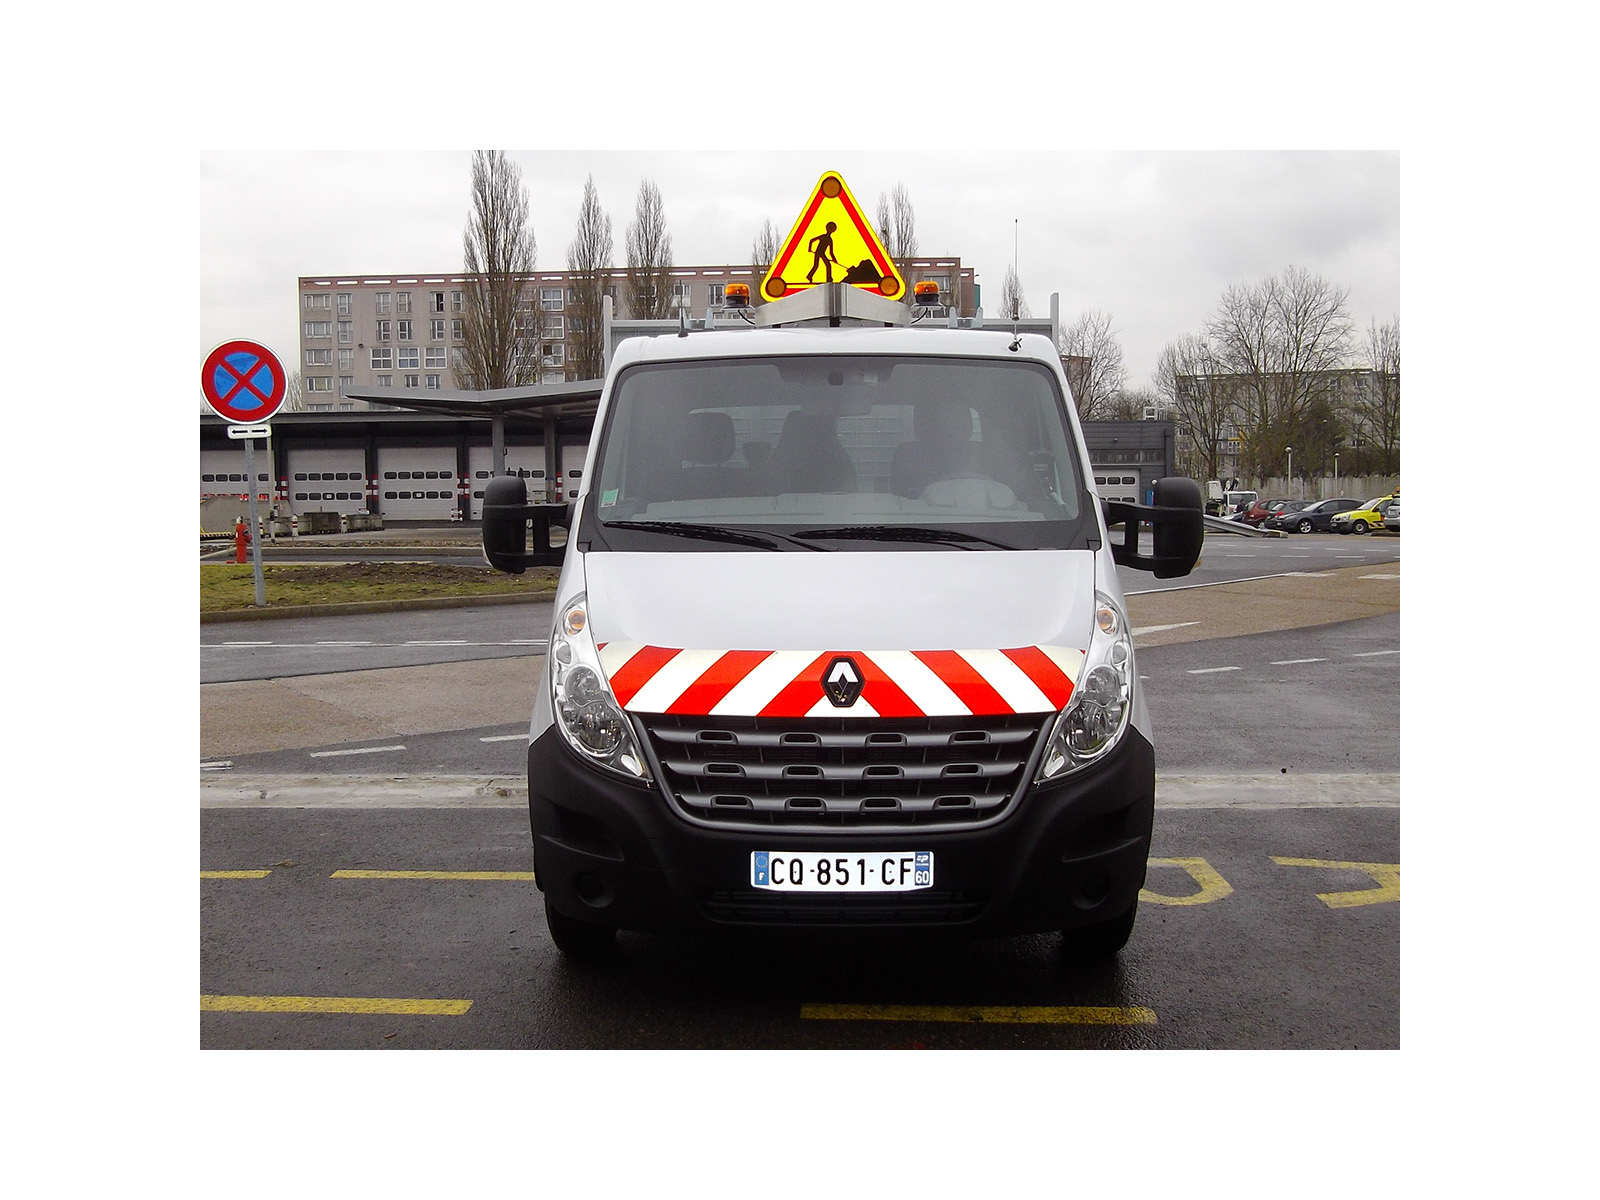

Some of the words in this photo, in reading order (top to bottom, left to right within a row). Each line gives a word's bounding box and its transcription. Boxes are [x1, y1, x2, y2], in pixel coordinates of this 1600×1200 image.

[758, 871, 765, 881] F
[771, 858, 914, 885] CQ-851-CF
[915, 870, 930, 884] 60
